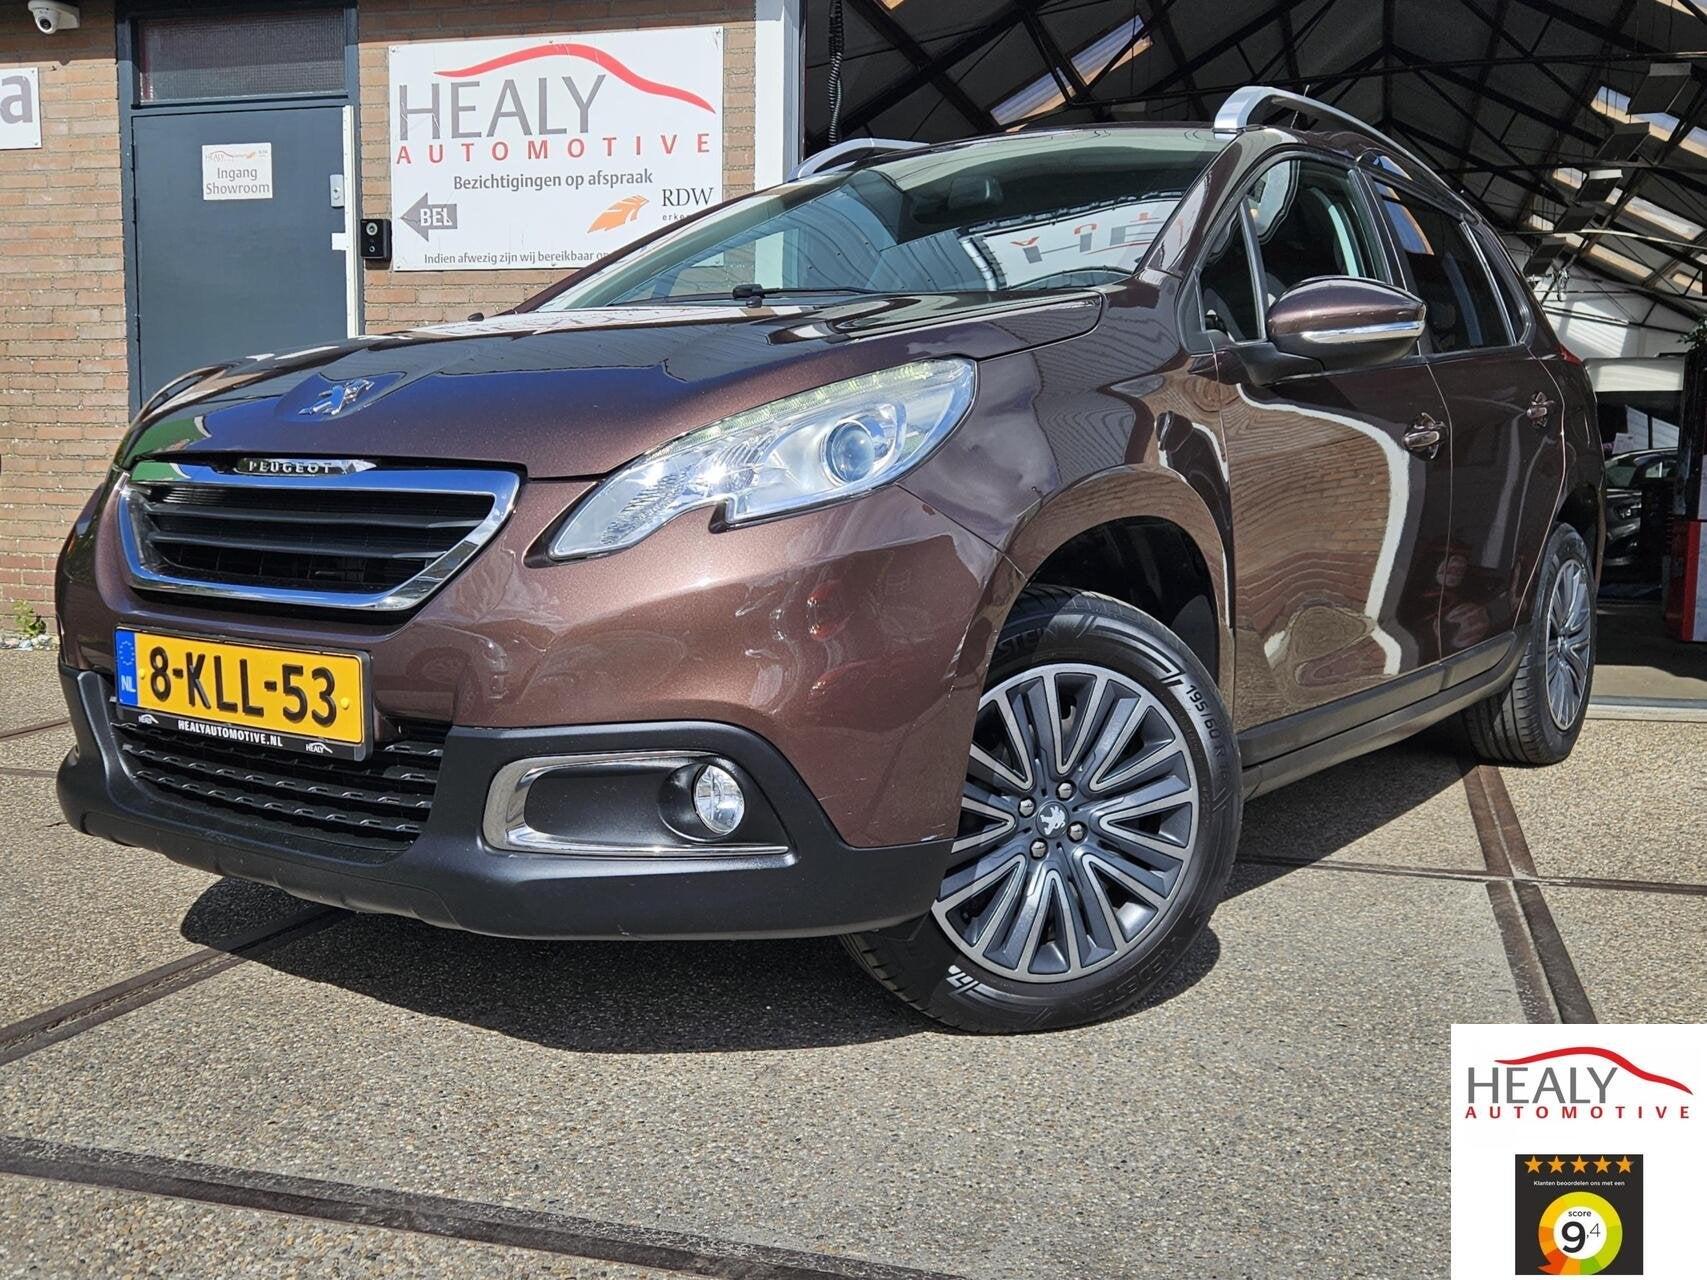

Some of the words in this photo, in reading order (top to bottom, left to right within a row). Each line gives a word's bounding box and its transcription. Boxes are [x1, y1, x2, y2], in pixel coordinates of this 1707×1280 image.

[398, 74, 606, 141] HEALY
[396, 133, 710, 164] AUTOMOTIVE
[217, 167, 258, 182] Ingang
[453, 172, 561, 191] Bezichtigingen
[565, 174, 584, 191] op
[587, 168, 653, 190] afspraak
[206, 182, 270, 195] Showroom
[662, 187, 714, 206] RDW
[420, 207, 453, 226] BEL
[662, 213, 688, 221] erke
[424, 253, 456, 264] Indien
[457, 252, 497, 265] afwezig
[499, 252, 518, 265] zijn
[519, 252, 536, 265] wij
[538, 250, 594, 262] bereikbaar
[248, 460, 332, 474] PEUGEOT
[121, 674, 136, 693] NL
[149, 646, 338, 728] 8-KLL-53
[1185, 684, 1221, 739] 195/60
[178, 719, 284, 747] HEALYAUTOMOTIVE.NL
